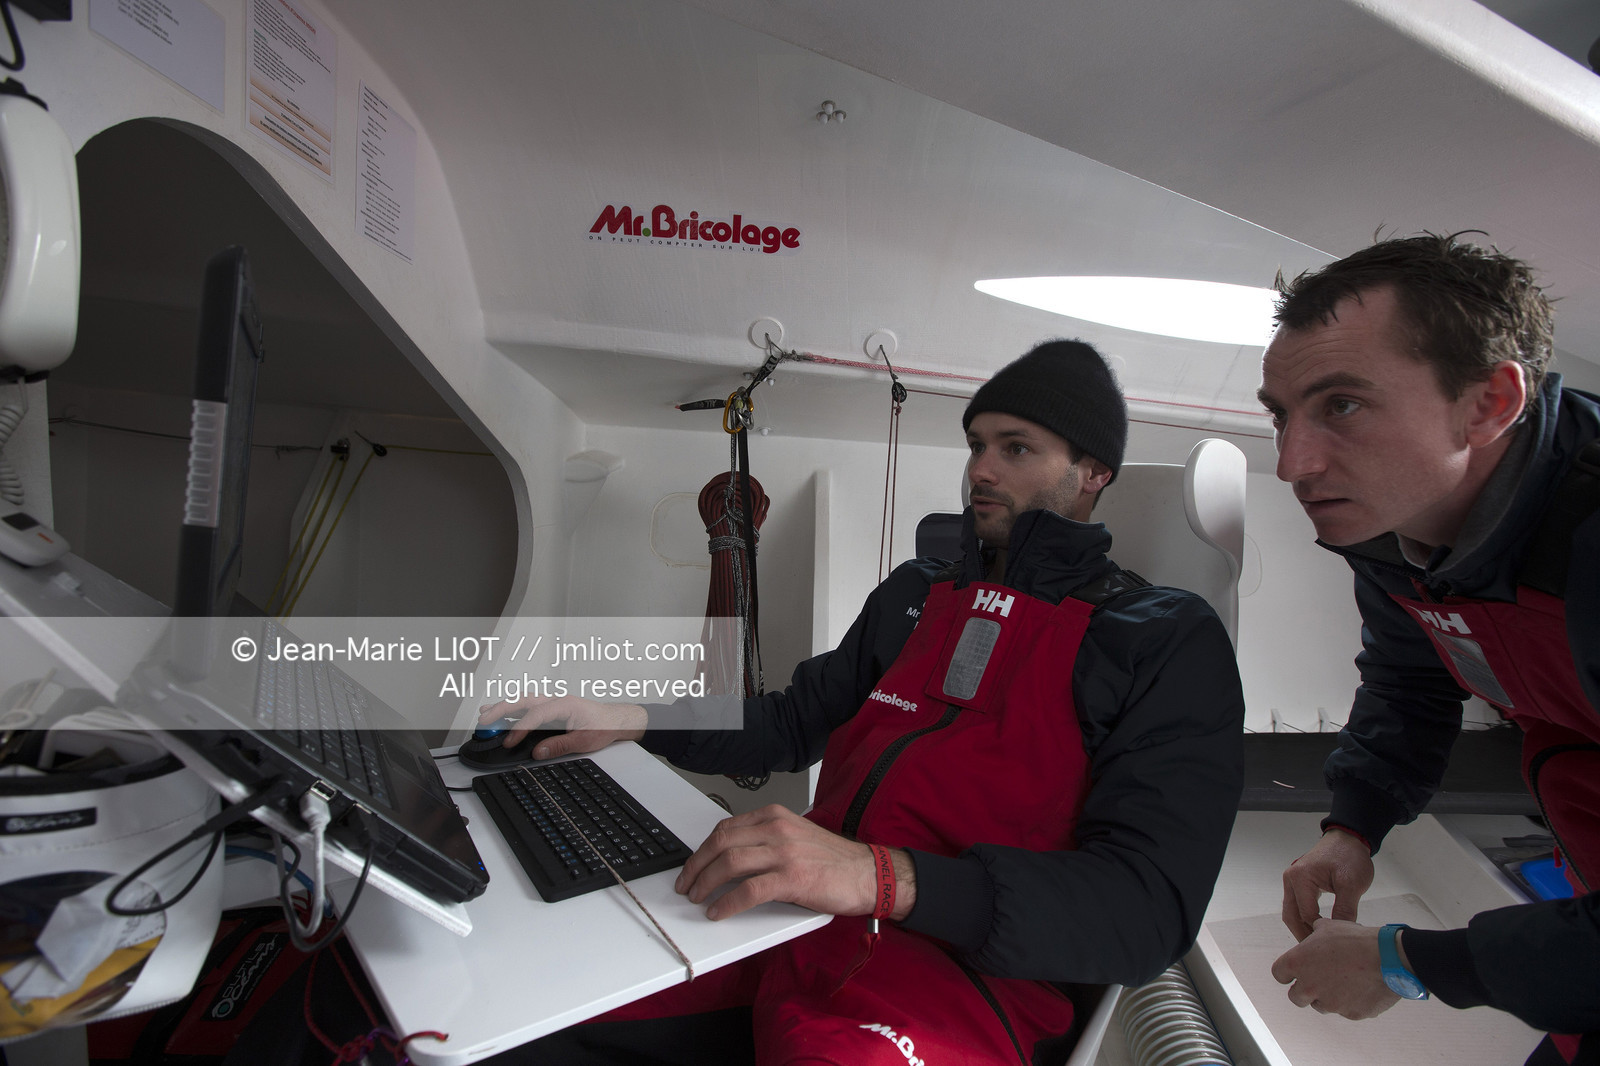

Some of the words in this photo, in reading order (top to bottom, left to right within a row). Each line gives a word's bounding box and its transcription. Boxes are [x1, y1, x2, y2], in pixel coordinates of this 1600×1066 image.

[589, 204, 800, 254] Mr.Bricolage
[650, 239, 703, 248] COMPTER
[880, 883, 892, 913] RACE
